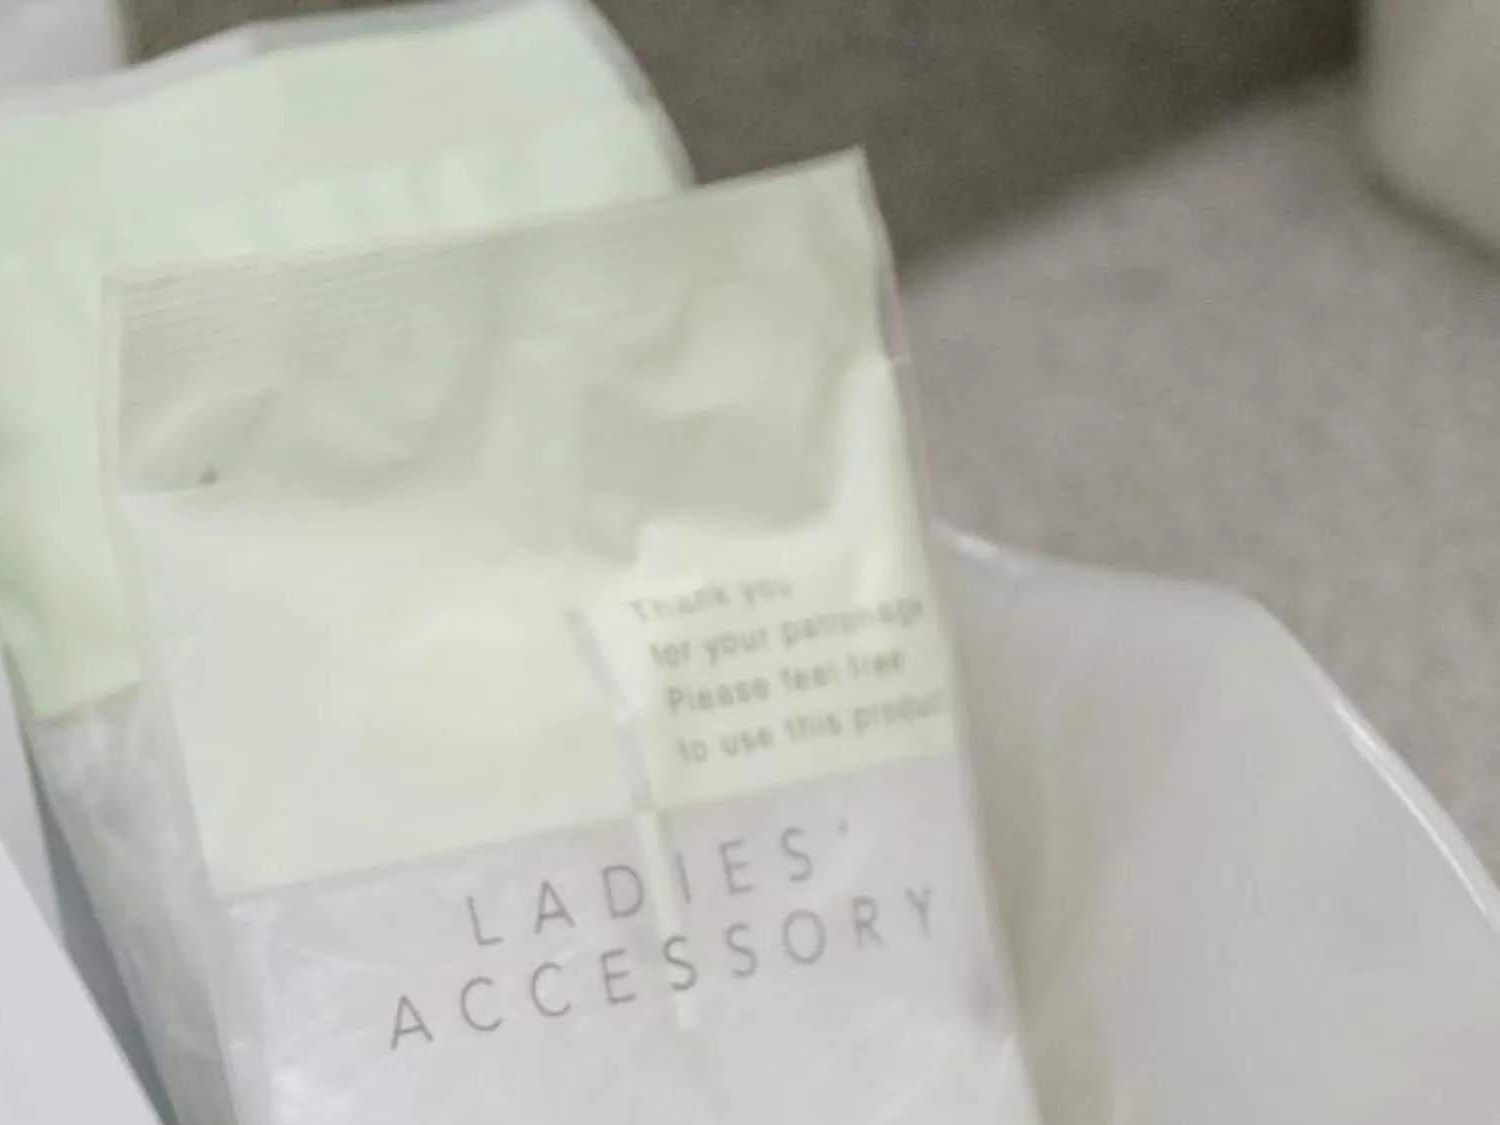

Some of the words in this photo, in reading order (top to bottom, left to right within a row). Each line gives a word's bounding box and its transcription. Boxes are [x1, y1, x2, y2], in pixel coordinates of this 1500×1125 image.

[650, 639, 692, 669] for
[703, 625, 769, 667] your
[665, 675, 771, 718] Please
[677, 736, 709, 764] to
[719, 724, 776, 757] use
[389, 885, 934, 1051] ACCESSORY
